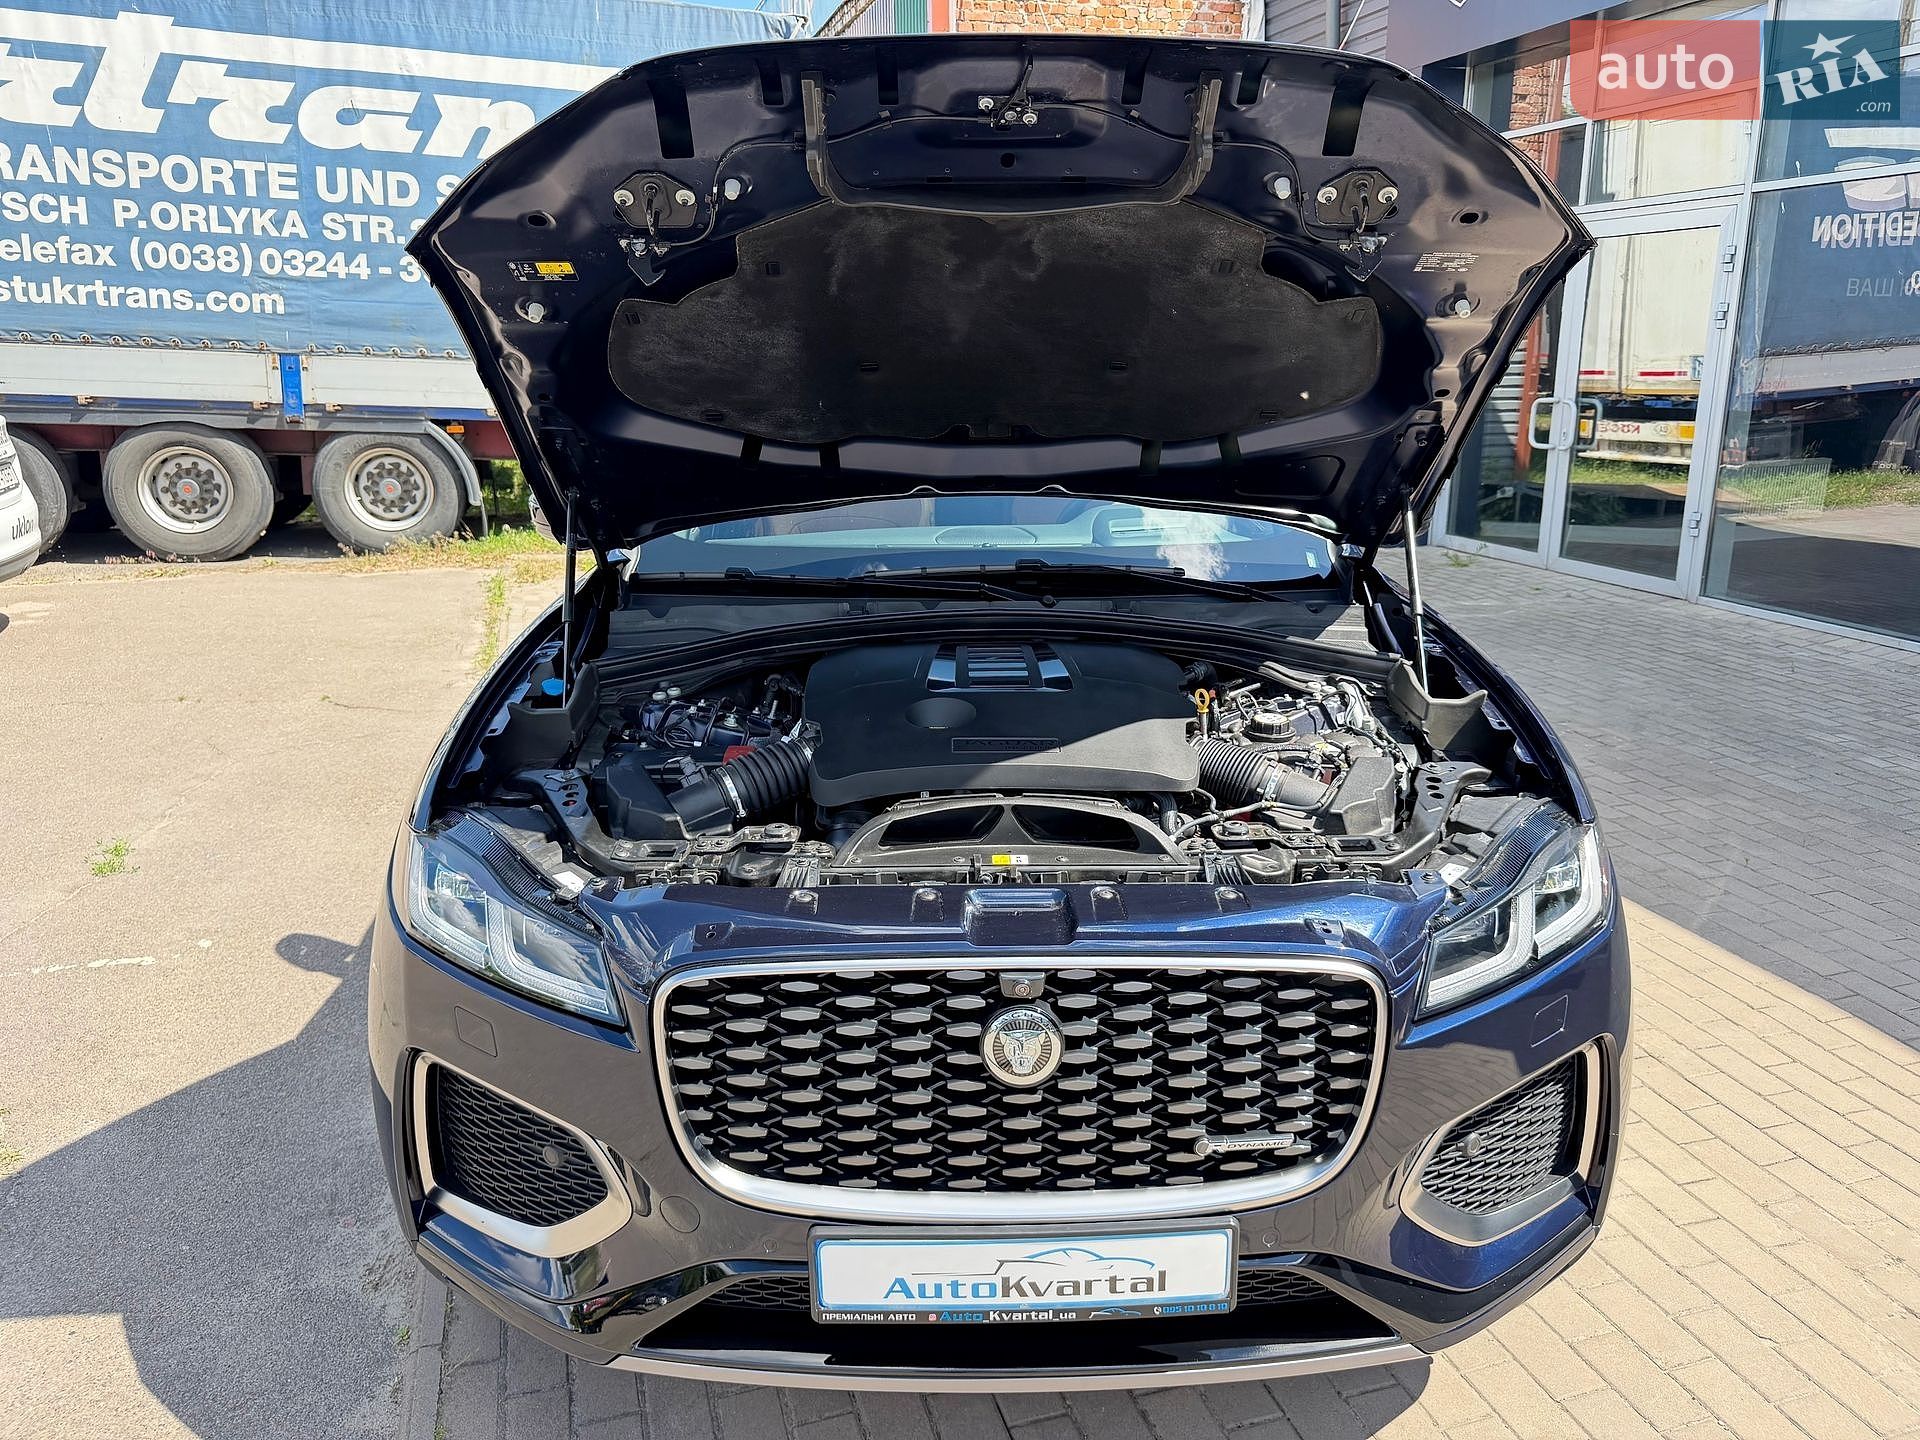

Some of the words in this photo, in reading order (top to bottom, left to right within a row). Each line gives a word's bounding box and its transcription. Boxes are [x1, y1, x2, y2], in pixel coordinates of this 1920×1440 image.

[315, 165, 420, 207] UND
[0, 191, 89, 226] SCH
[113, 198, 309, 239] P.ORLYKA
[0, 233, 117, 267] elefax
[130, 236, 252, 277] (0038)
[259, 247, 372, 281] 03244
[399, 255, 431, 283] 3
[12, 515, 34, 540] uklon
[883, 1269, 1167, 1299] AutoKvartal
[887, 1313, 916, 1321] АВТО
